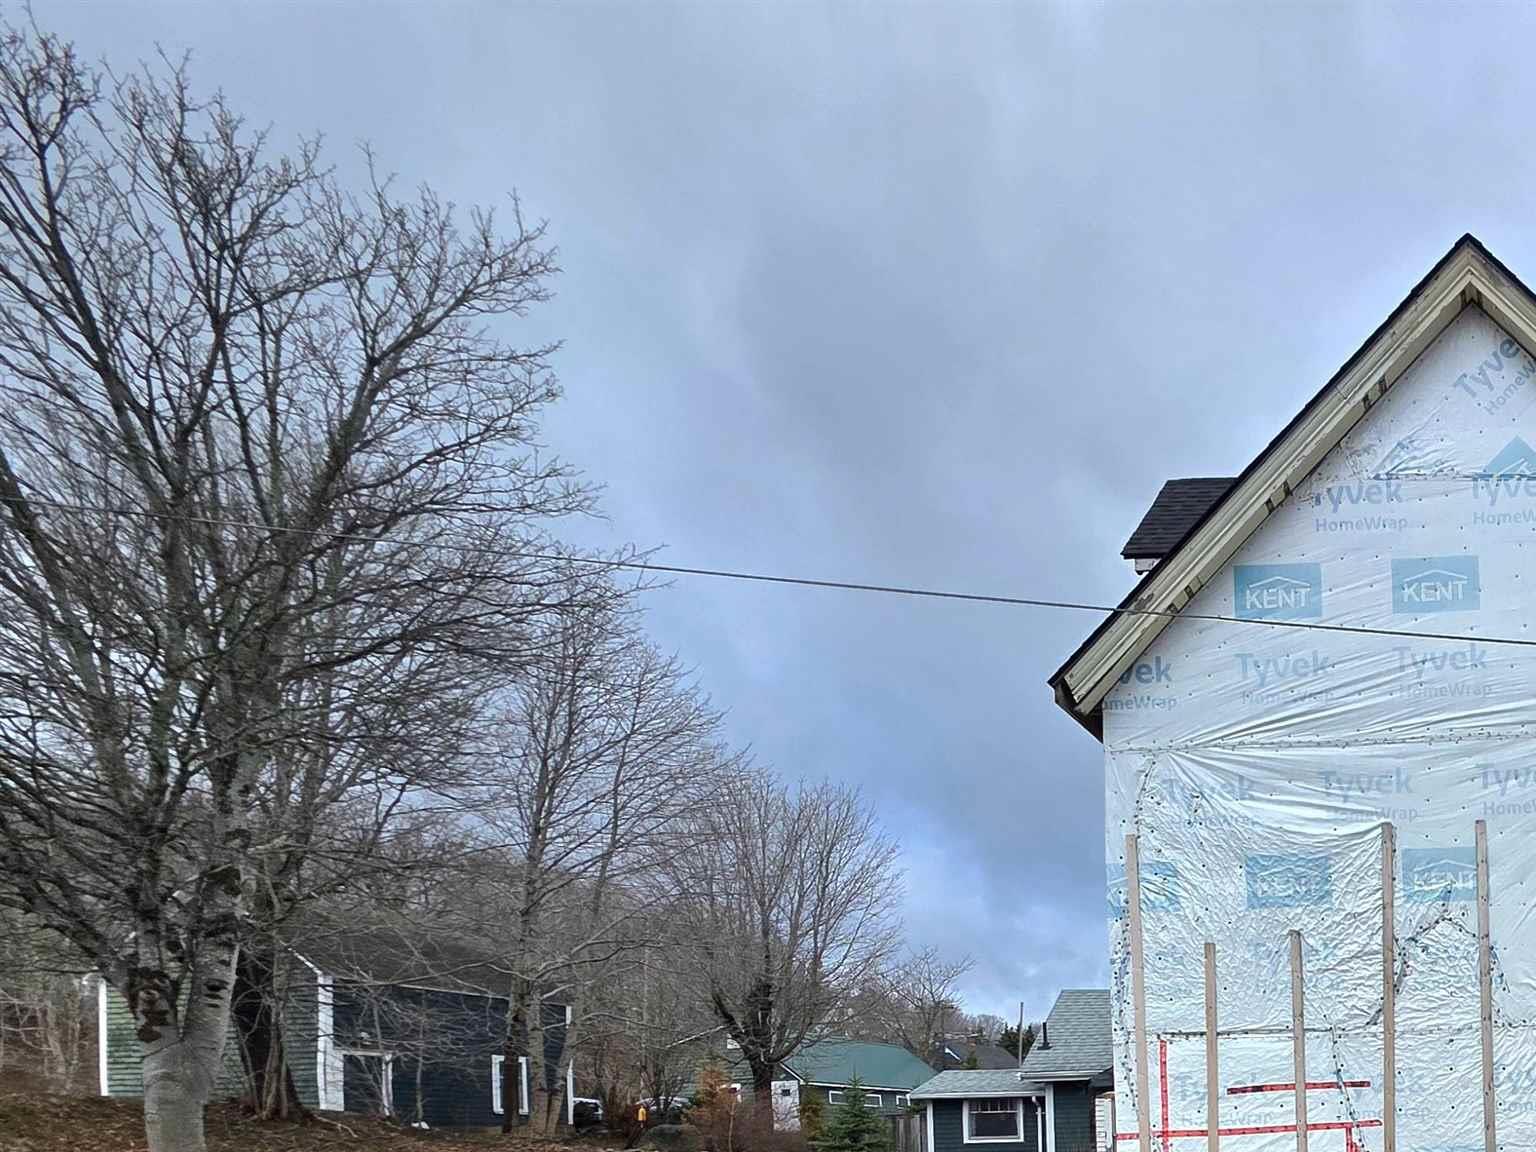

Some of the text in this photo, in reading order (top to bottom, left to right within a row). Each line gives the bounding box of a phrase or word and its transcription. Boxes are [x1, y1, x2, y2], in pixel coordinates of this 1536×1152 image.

[1453, 338, 1520, 398] Tyve
[1484, 360, 1536, 415] HomeW
[1315, 517, 1408, 534] HomeWrap
[1246, 588, 1312, 609] KENT
[1404, 580, 1468, 602] KENT
[1120, 656, 1172, 684] vek
[1234, 651, 1330, 687] Tyvek
[1392, 643, 1488, 679] Tyvek
